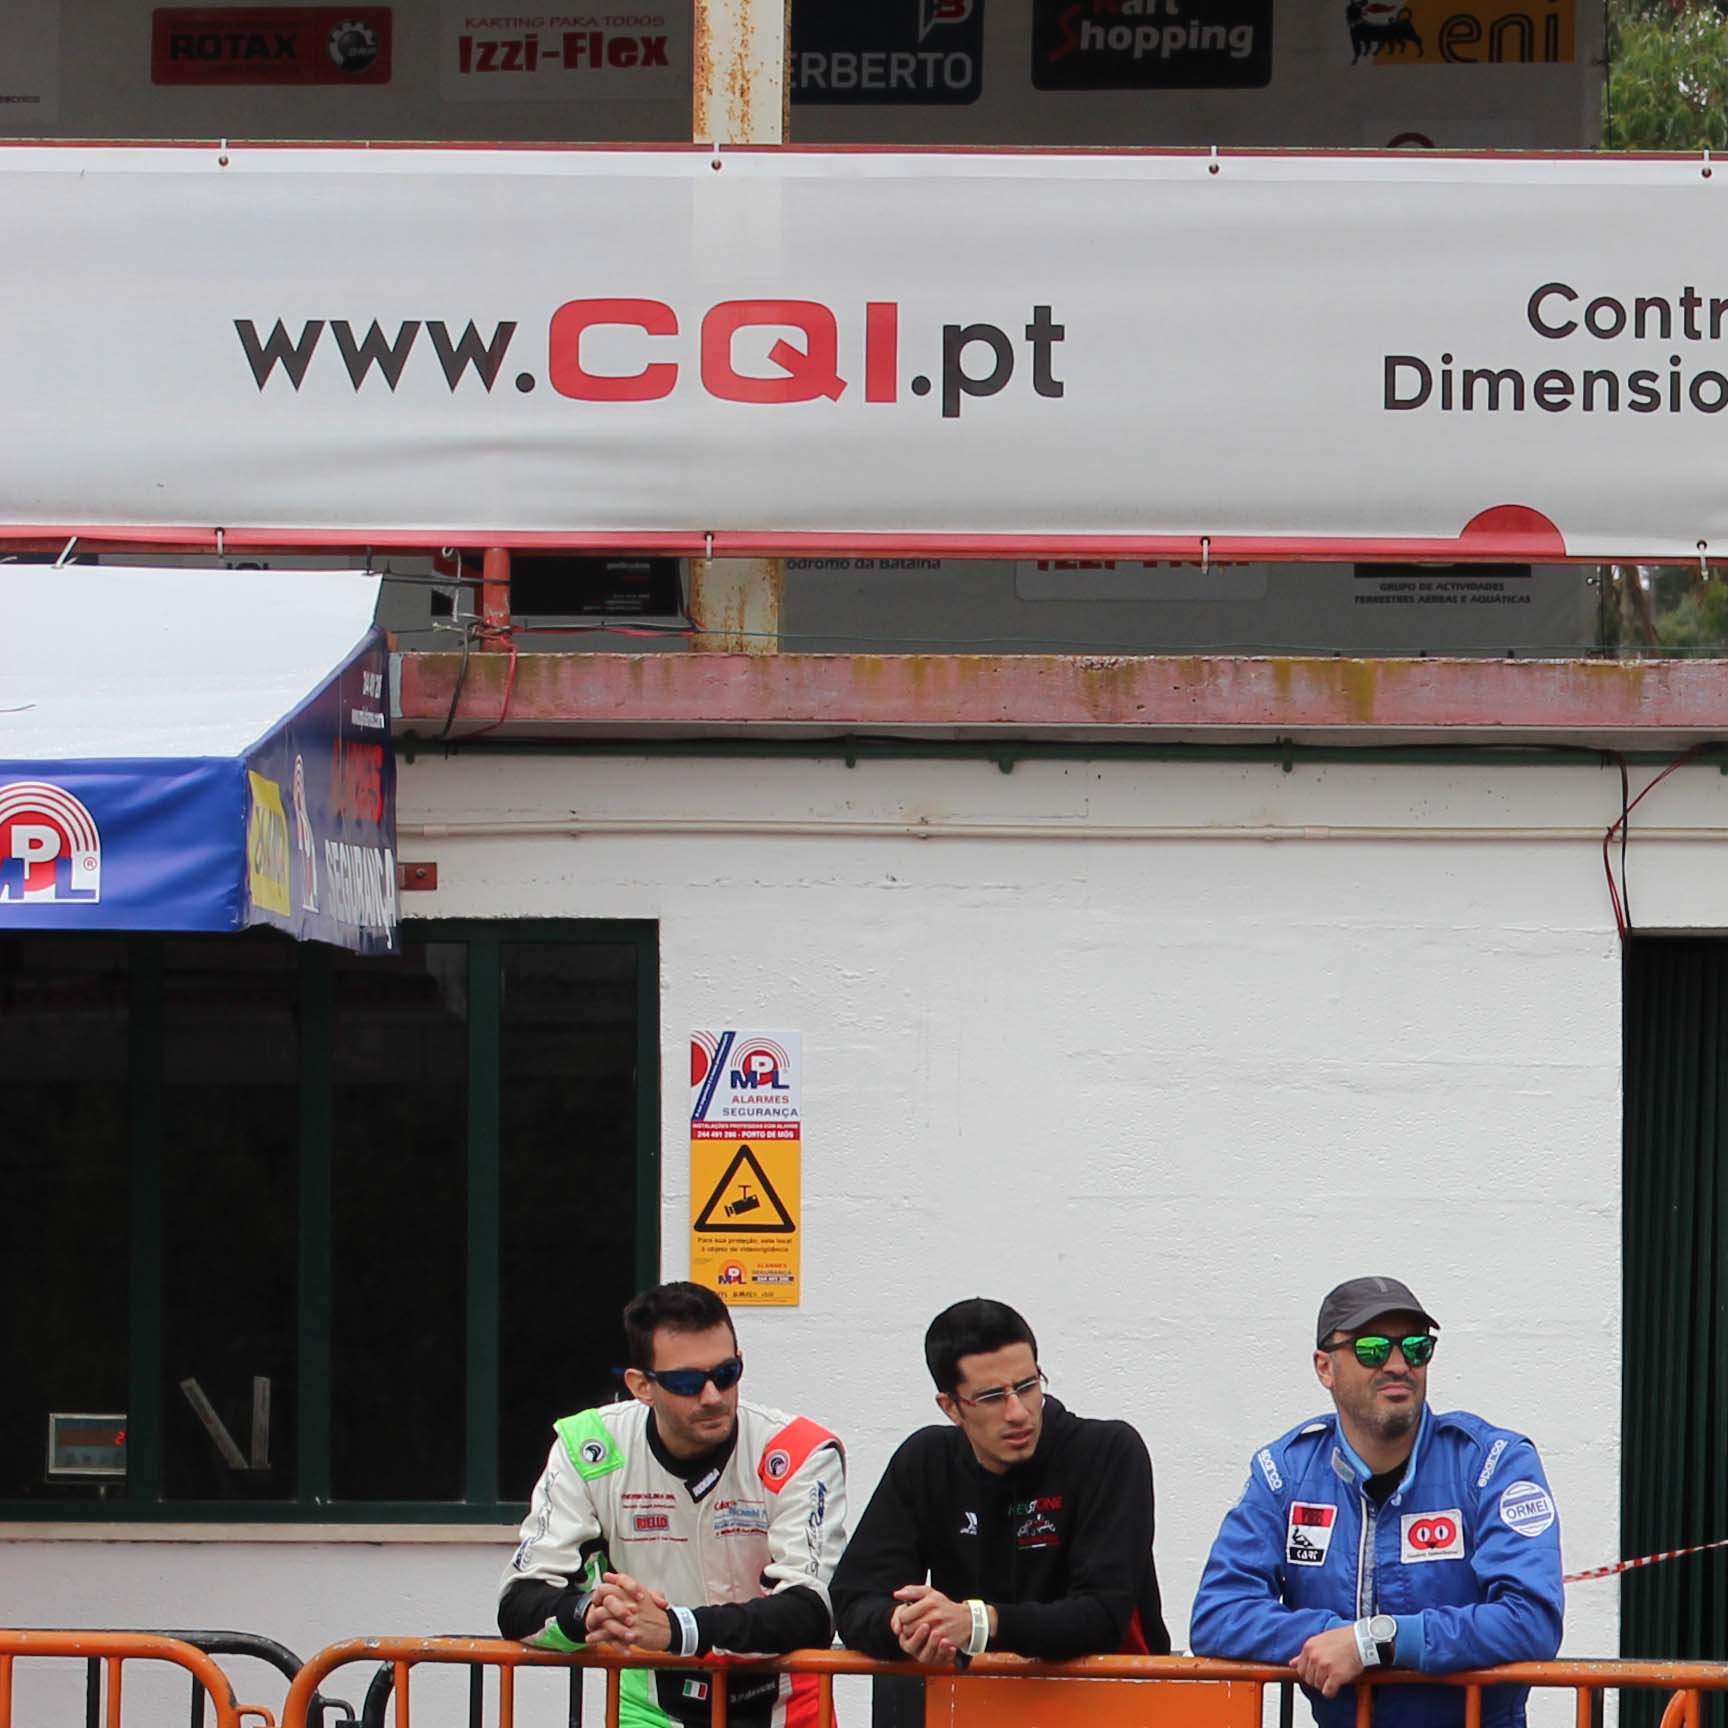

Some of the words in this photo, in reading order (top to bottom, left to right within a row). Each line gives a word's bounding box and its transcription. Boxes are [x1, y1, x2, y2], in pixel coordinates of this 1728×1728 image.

[465, 18, 545, 29] KARTING
[601, 15, 665, 27] TODOS
[1049, 8, 1254, 61] Shopping
[1439, 13, 1559, 63] eni
[170, 32, 297, 60] ROTAX
[459, 32, 669, 73] Izzi-Flex
[234, 298, 1064, 418] www.CQI.pt
[1380, 582, 1415, 591] GRUPO
[1420, 582, 1432, 591] DE
[722, 1107, 799, 1119] SEGURANÇA
[732, 1095, 790, 1105] ALARMES
[1260, 1449, 1283, 1489] sparco
[1477, 1439, 1507, 1487] sparco
[1506, 1500, 1549, 1519] ORMEI
